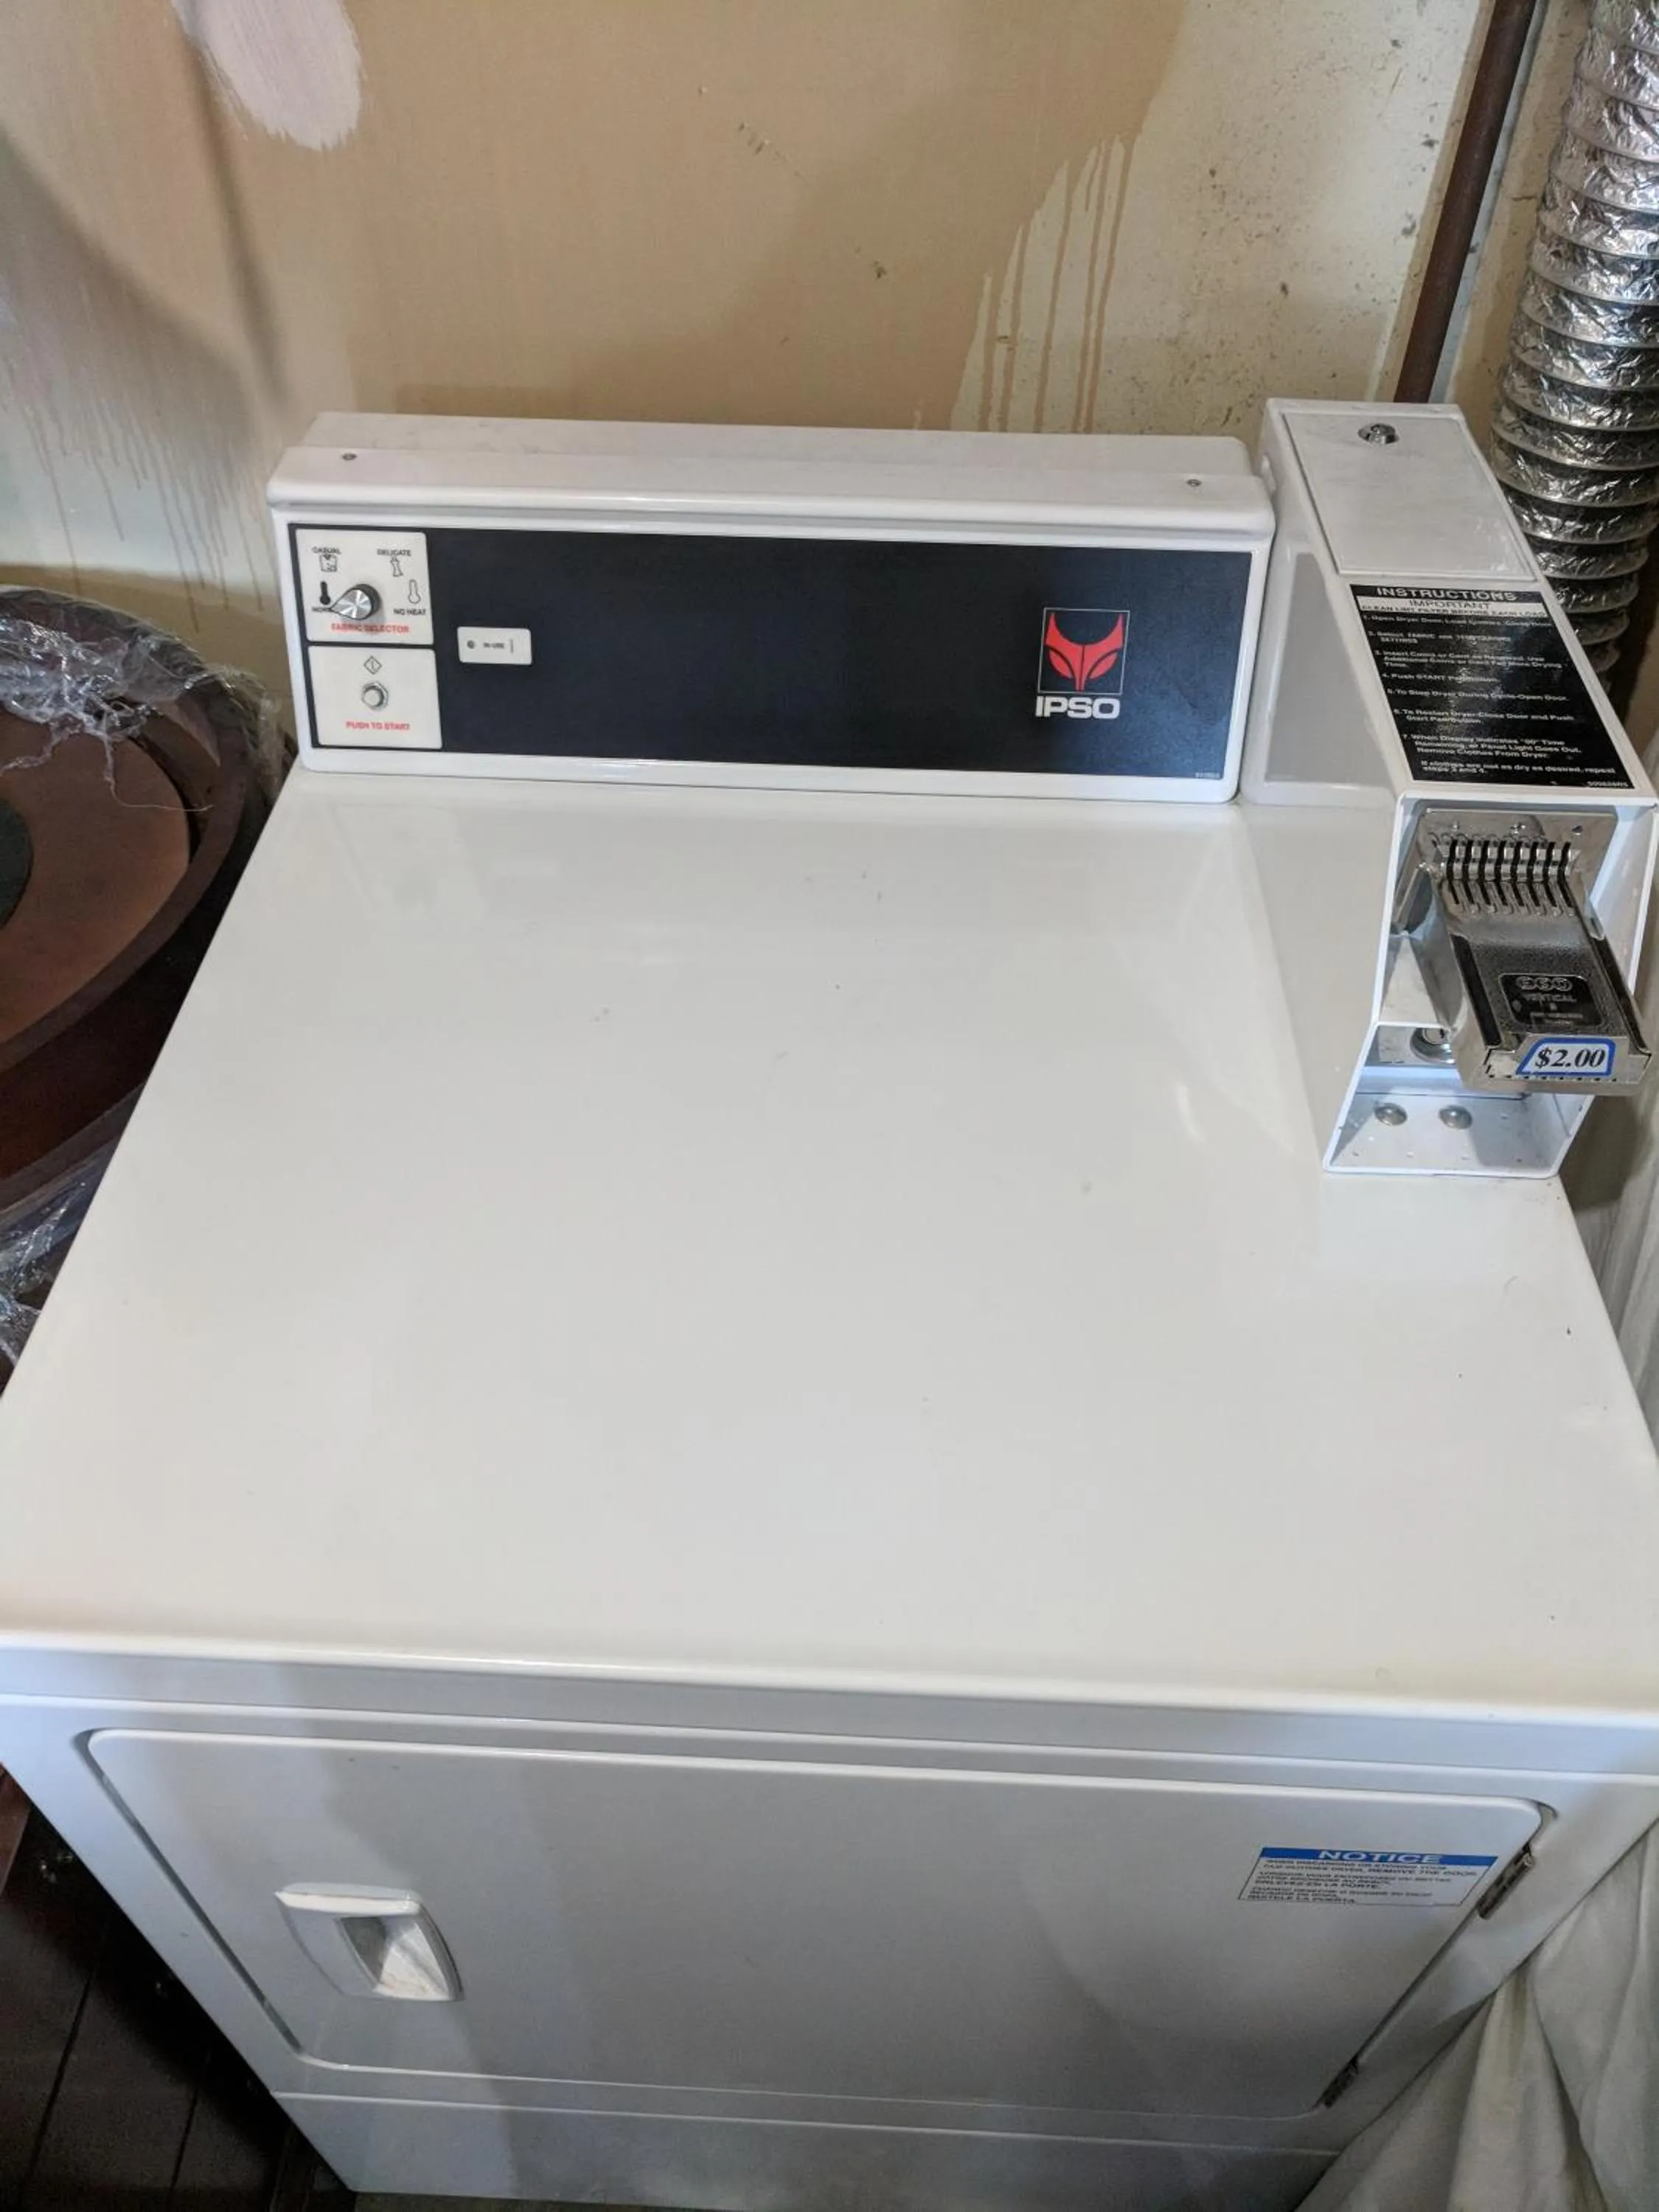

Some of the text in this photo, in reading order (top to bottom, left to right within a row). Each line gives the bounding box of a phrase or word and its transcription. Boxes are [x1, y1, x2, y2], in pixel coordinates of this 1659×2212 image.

[377, 549, 411, 557] DELICATE
[1377, 587, 1517, 601] INSTRUCTIONS
[1409, 599, 1490, 609] IMPORTANT
[331, 623, 410, 633] FABRIC SELECTOR
[1035, 695, 1121, 720] IPSO
[346, 721, 410, 731] PUSH TO START
[1509, 745, 1533, 753] Light
[1514, 765, 1531, 773] dry
[1534, 1047, 1606, 1069] $2.00
[1319, 1849, 1441, 1864] NOTICE
